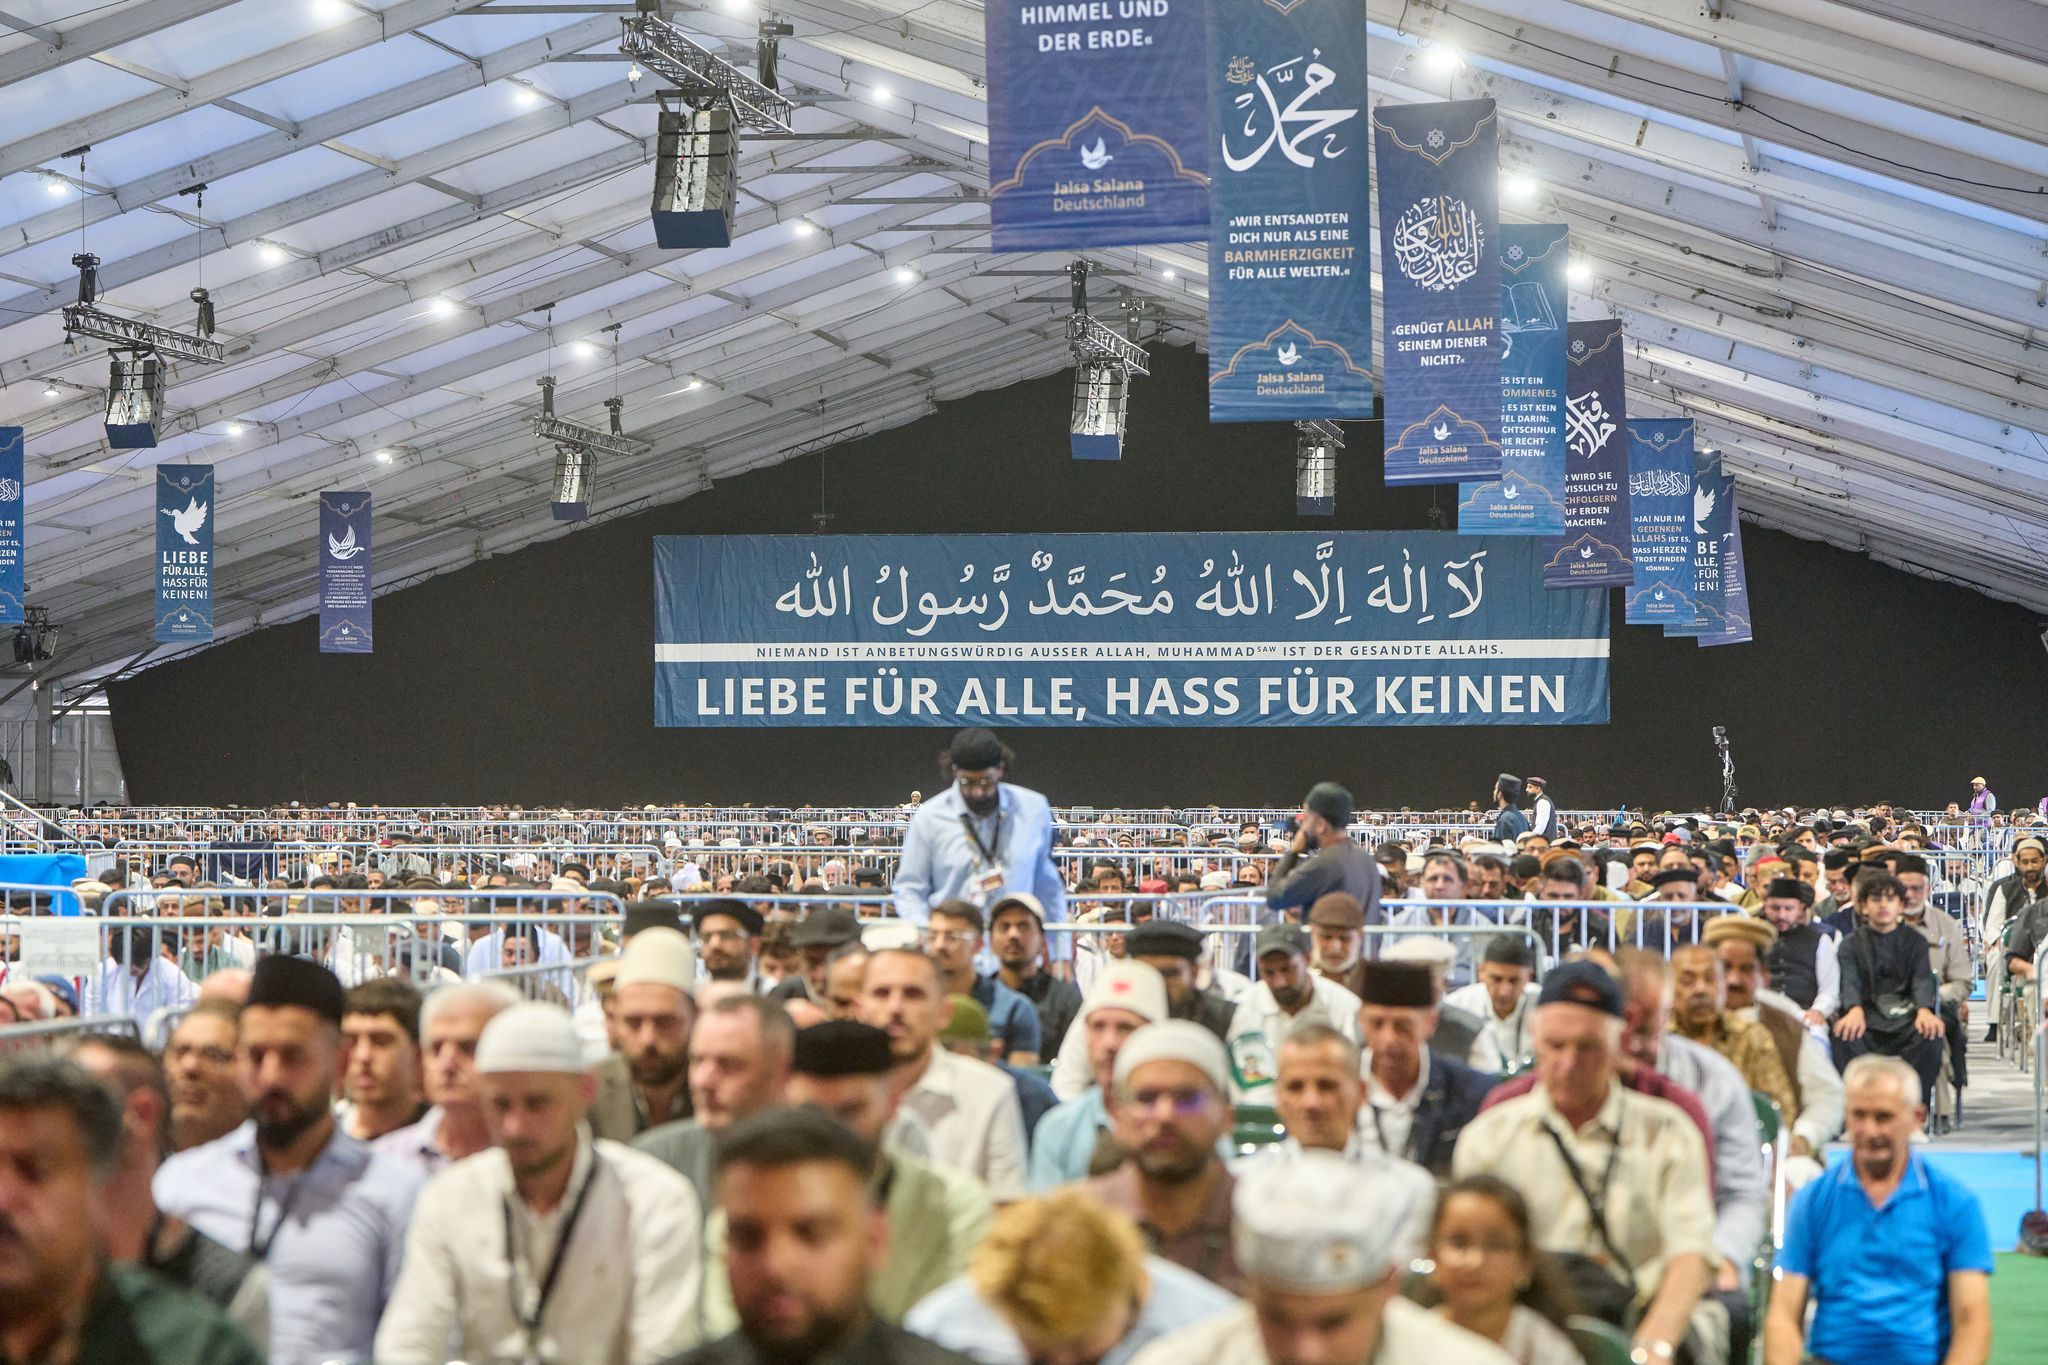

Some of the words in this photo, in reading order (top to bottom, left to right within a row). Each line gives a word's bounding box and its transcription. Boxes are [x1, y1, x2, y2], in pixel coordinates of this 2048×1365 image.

[1021, 2, 1113, 25] HIMMEL
[1119, 0, 1169, 18] UND
[1038, 32, 1081, 52] DER
[1053, 180, 1090, 196] Jalsa
[1093, 177, 1144, 193] Salana
[1053, 193, 1145, 212] Deutschland
[1229, 215, 1262, 227] »WIR
[1264, 213, 1349, 226] ENTSANDTEN
[1229, 232, 1260, 244] DICH
[1263, 231, 1292, 243] NUR
[1294, 230, 1317, 242] ALS
[1320, 229, 1349, 241] EINE
[1224, 247, 1355, 263] BARMHERZIGKEIT
[1229, 266, 1254, 280] FÜR
[1257, 267, 1287, 279] ALLE
[1446, 317, 1493, 333] ALLAH
[1398, 339, 1442, 352] SEINEM
[1445, 336, 1487, 349] DIENER
[1257, 373, 1284, 384] Jalsa
[1286, 372, 1324, 383] Salana
[1512, 376, 1526, 385] IST
[1528, 377, 1543, 385] EIN
[1257, 384, 1325, 396] Deutschland
[1502, 388, 1557, 398] OMMENES
[1507, 403, 1518, 412] ES
[1520, 404, 1534, 412] IST
[1535, 404, 1557, 412] KEIN
[1517, 415, 1549, 423] DARIN:
[1502, 426, 1557, 434] CHTSCHNUR
[1515, 437, 1549, 446] RECHT-
[1418, 454, 1468, 465] Deutschland
[1571, 472, 1596, 481] WIRD
[1598, 471, 1612, 480] SIE
[1605, 483, 1618, 491] ZU
[1565, 494, 1617, 504] CHFOLGERN
[1489, 510, 1535, 520] Deutschland
[1565, 507, 1577, 516] UF
[1579, 506, 1610, 515] ERDEN
[1653, 515, 1672, 523] NUR
[1674, 515, 1686, 523] IM
[1637, 525, 1682, 533] GEDENKEN
[1681, 536, 1691, 544] ES,
[0, 549, 17, 557] ZEN
[1652, 546, 1687, 554] HERZEN
[1697, 541, 1719, 555] BE
[163, 551, 208, 564] LIEBE
[162, 564, 181, 576] FÜR
[182, 566, 208, 577] ALLE,
[1569, 567, 1608, 576] Deutschland
[1698, 568, 1719, 579] FÜR
[162, 578, 188, 588] HASS
[189, 576, 208, 588] FÜR
[162, 590, 208, 600] KEINEN!
[757, 647, 830, 658] NIEMAND
[836, 647, 859, 657] IST
[866, 645, 1024, 657] ANBETUNGSWÜRDIG
[1030, 646, 1089, 657] AUSSER
[1095, 645, 1150, 658] ALLAH,
[1282, 645, 1307, 657] IST
[1313, 645, 1343, 656] DER
[1349, 644, 1432, 656] GESANDTE
[1438, 643, 1504, 655] ALLAHS.
[697, 676, 826, 715] LIEBE
[845, 667, 942, 715] FÜR
[955, 676, 1087, 722] ALLE,
[1107, 676, 1240, 716] HASS
[1259, 666, 1358, 715] FÜR
[1375, 674, 1566, 714] KEINEN
